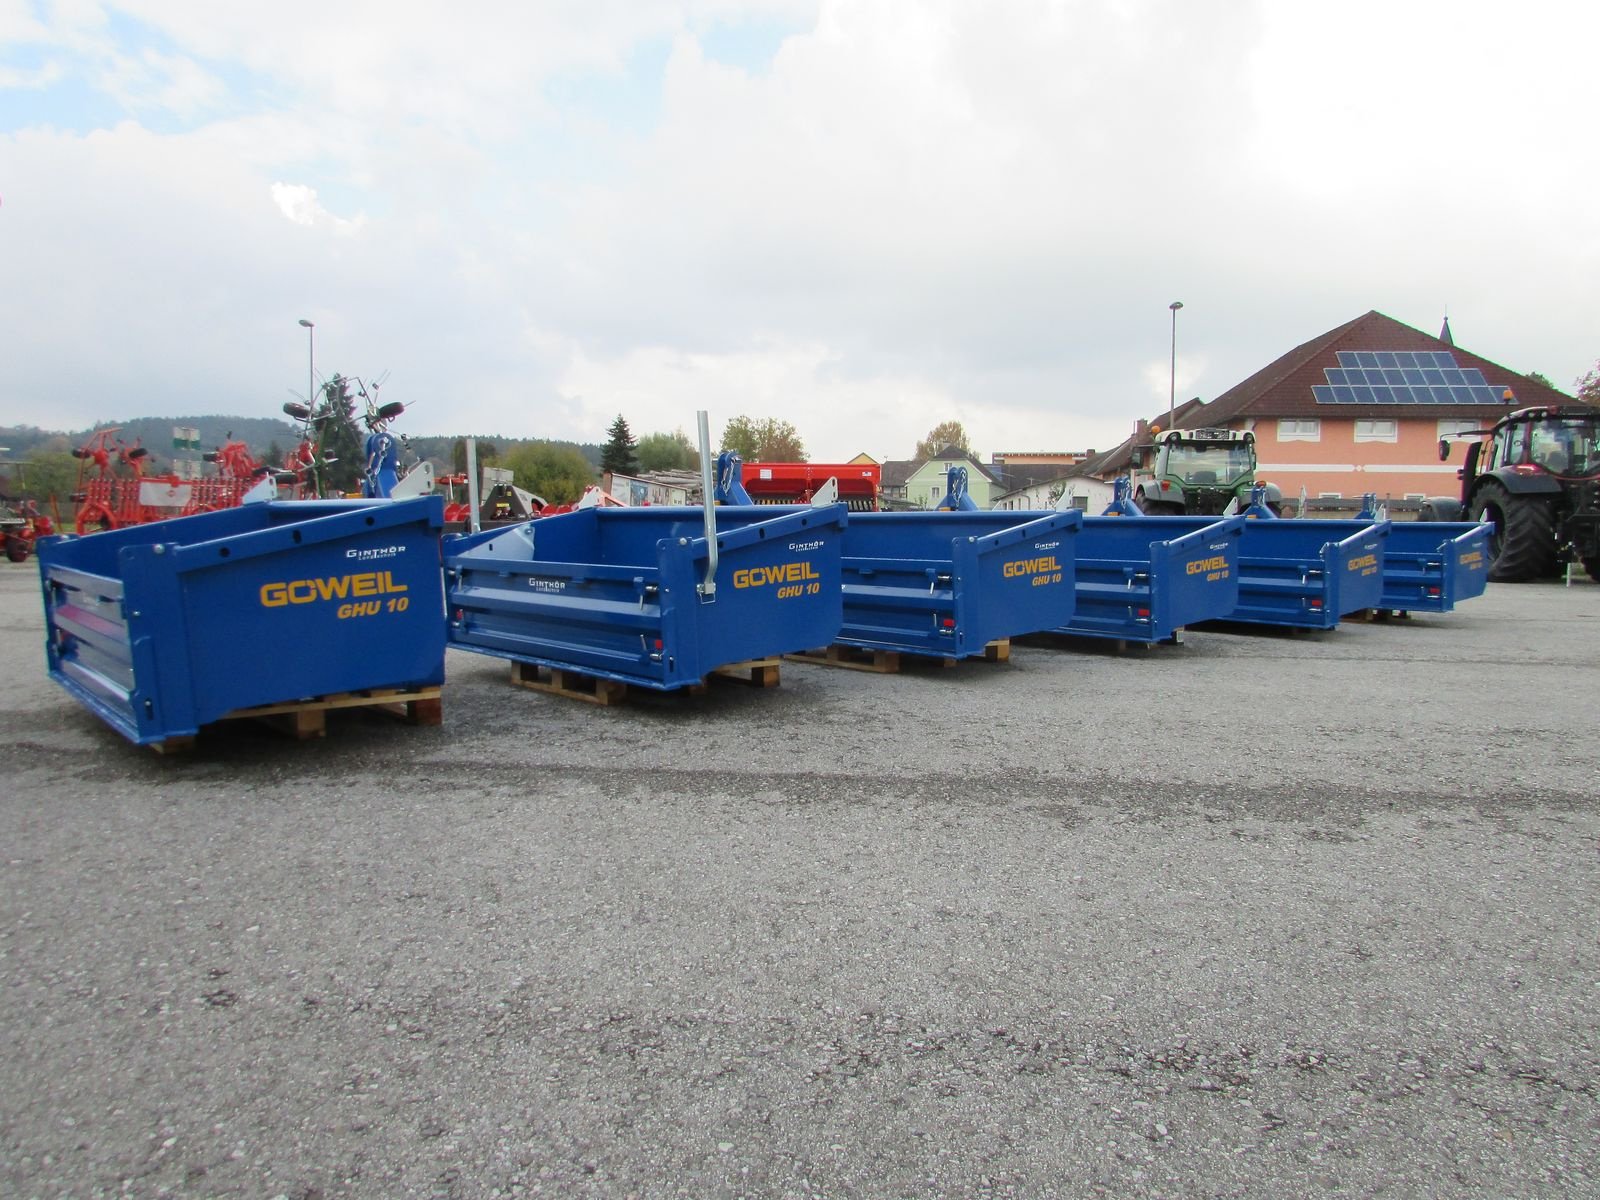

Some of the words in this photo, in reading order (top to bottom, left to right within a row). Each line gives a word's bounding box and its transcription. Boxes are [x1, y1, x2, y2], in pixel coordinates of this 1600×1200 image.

[1032, 575, 1050, 587] GHU
[1052, 573, 1062, 583] 10
[777, 585, 803, 599] GHU
[806, 582, 820, 594] 10
[337, 600, 380, 619] GHU
[387, 597, 409, 613] 10
